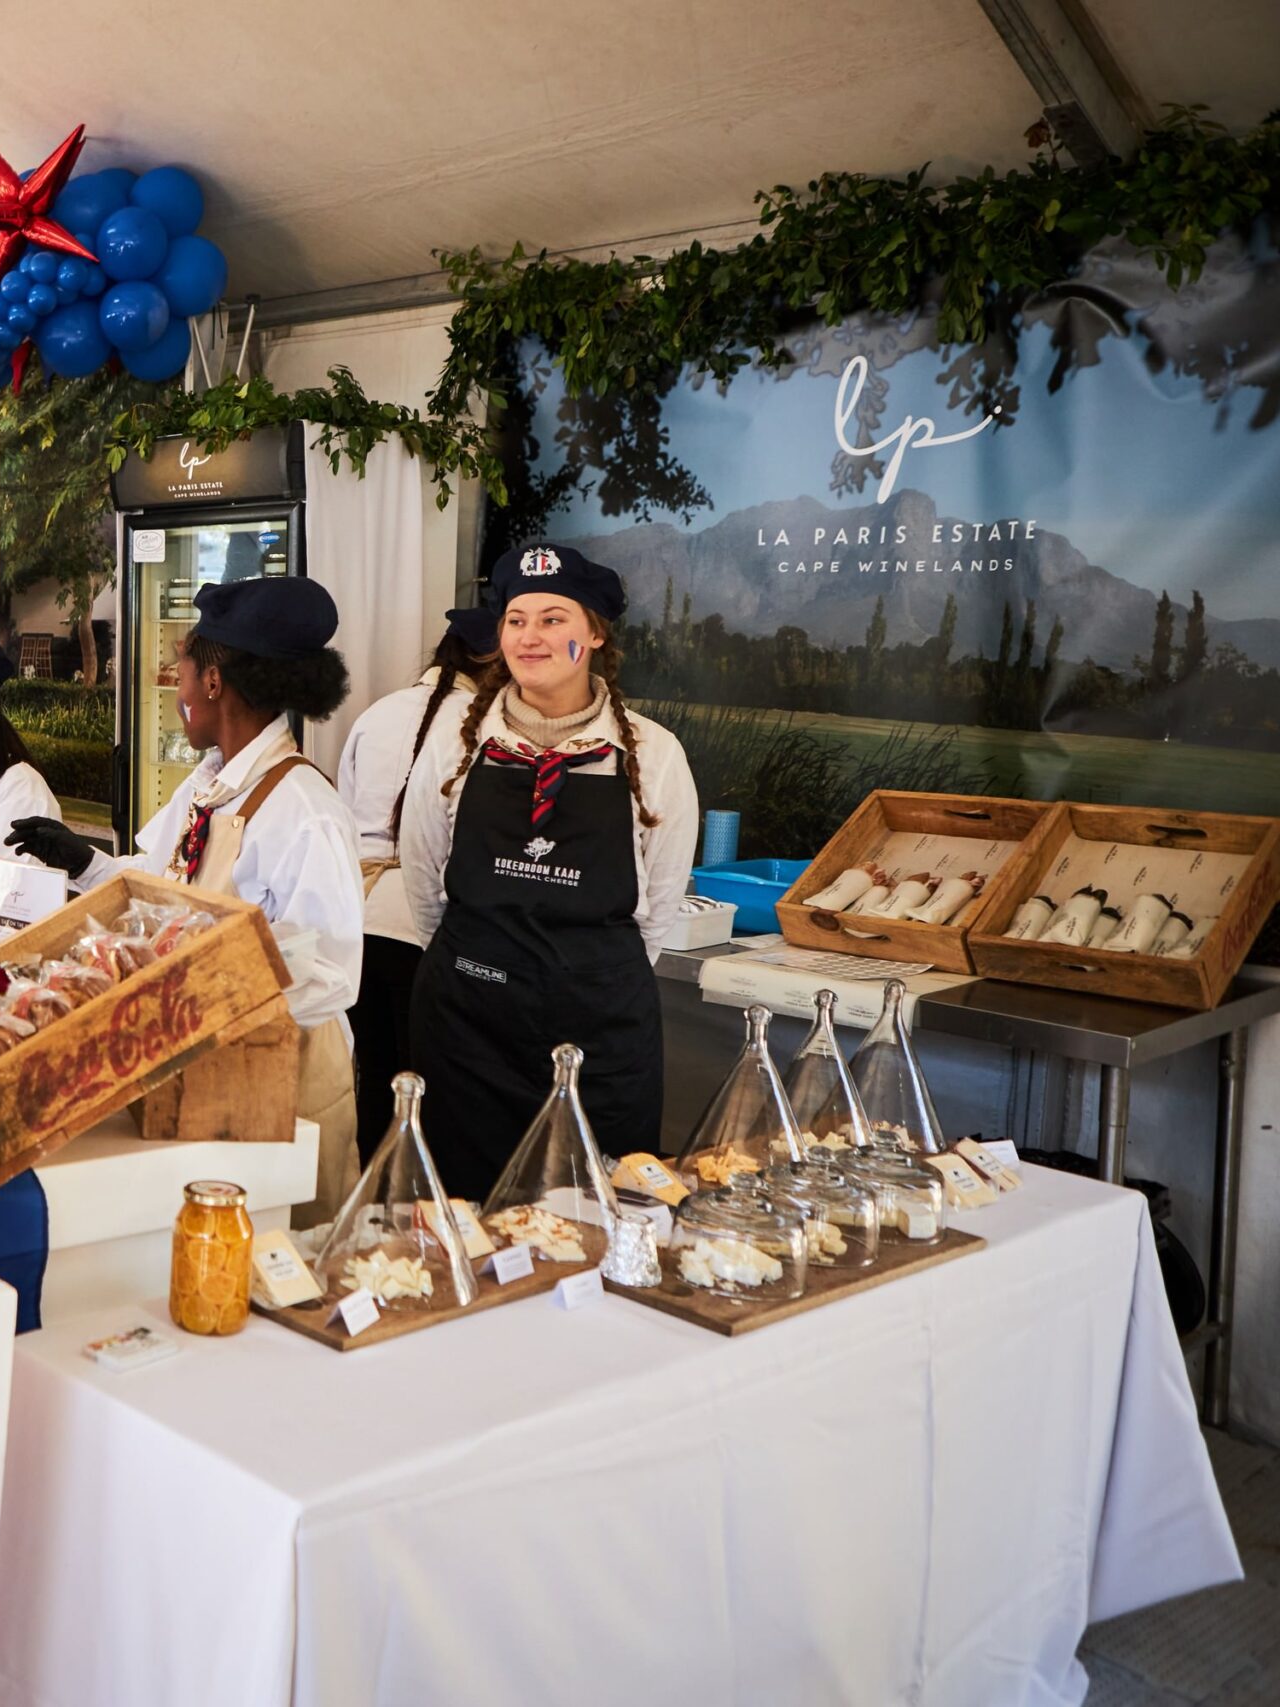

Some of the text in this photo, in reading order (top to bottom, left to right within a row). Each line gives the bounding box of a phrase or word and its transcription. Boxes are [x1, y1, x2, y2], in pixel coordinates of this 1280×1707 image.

[178, 483, 198, 491] PARIS
[200, 481, 224, 490] ESTATE
[757, 519, 1037, 546] LA PARIS ESTATE
[778, 558, 1014, 573] CAPE WINELANDS
[493, 869, 543, 881] ARTISANAL
[494, 857, 582, 880] KOKERBOOM KAAS
[456, 959, 504, 979] STREAMLINE
